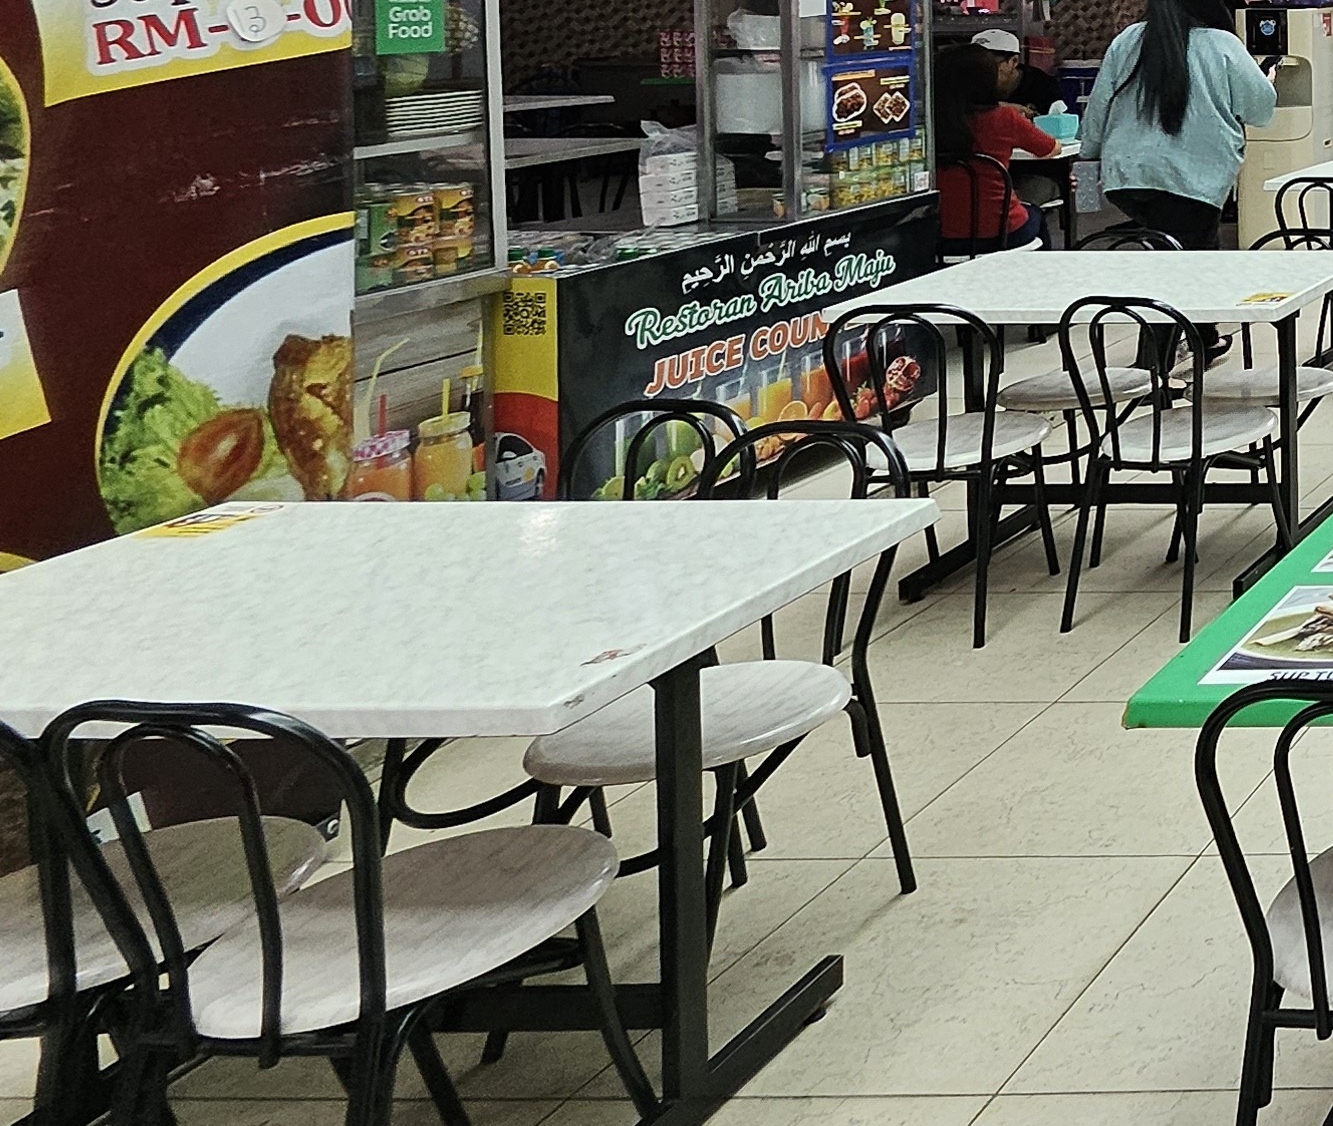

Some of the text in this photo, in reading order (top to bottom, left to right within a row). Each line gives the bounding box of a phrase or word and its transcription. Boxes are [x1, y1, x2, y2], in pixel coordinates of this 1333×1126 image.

[388, 5, 432, 22] Grab
[388, 21, 433, 39] Food
[625, 249, 897, 349] Restoran Ariba Maju
[644, 334, 747, 396] JUICE
